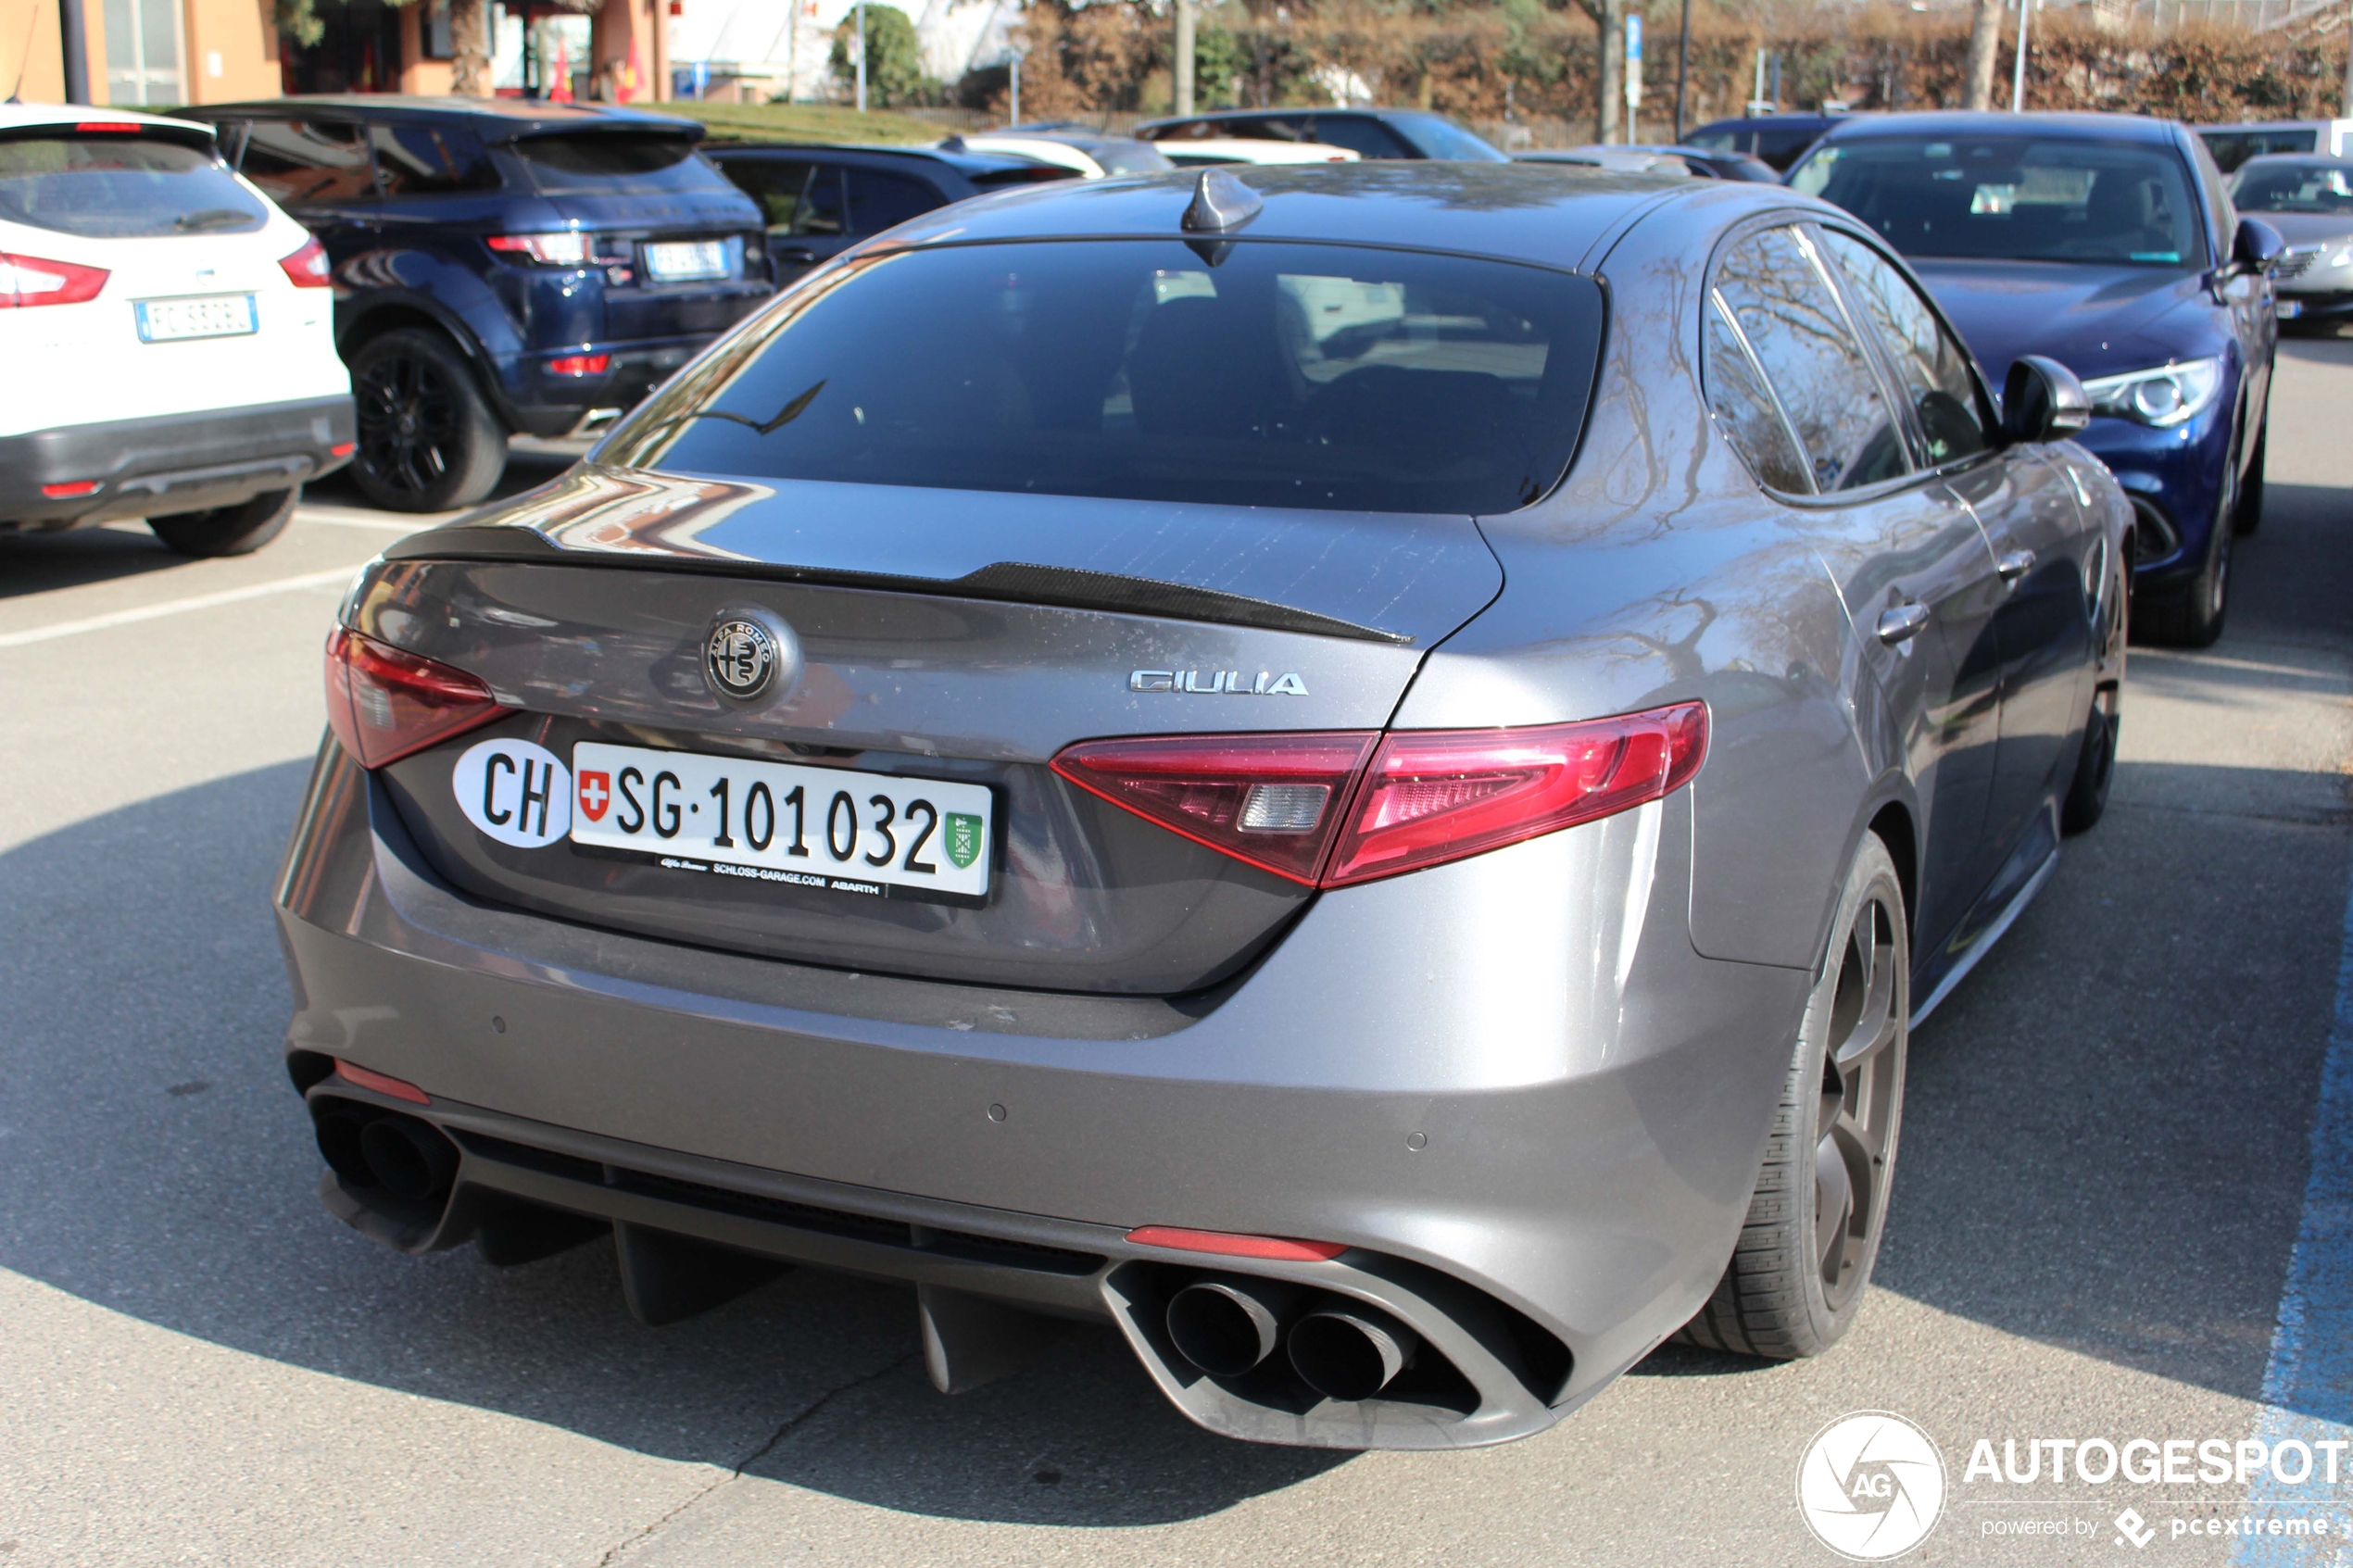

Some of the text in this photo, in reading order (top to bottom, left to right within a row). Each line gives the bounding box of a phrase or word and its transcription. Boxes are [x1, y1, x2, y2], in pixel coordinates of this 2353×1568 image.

[711, 623, 770, 662] ALFA ROMEO
[1130, 670, 1309, 696] GIULIA
[484, 752, 553, 837] CH
[712, 862, 825, 887] SCHLOSS-GARAGE.COM
[830, 881, 880, 896] ABARTH
